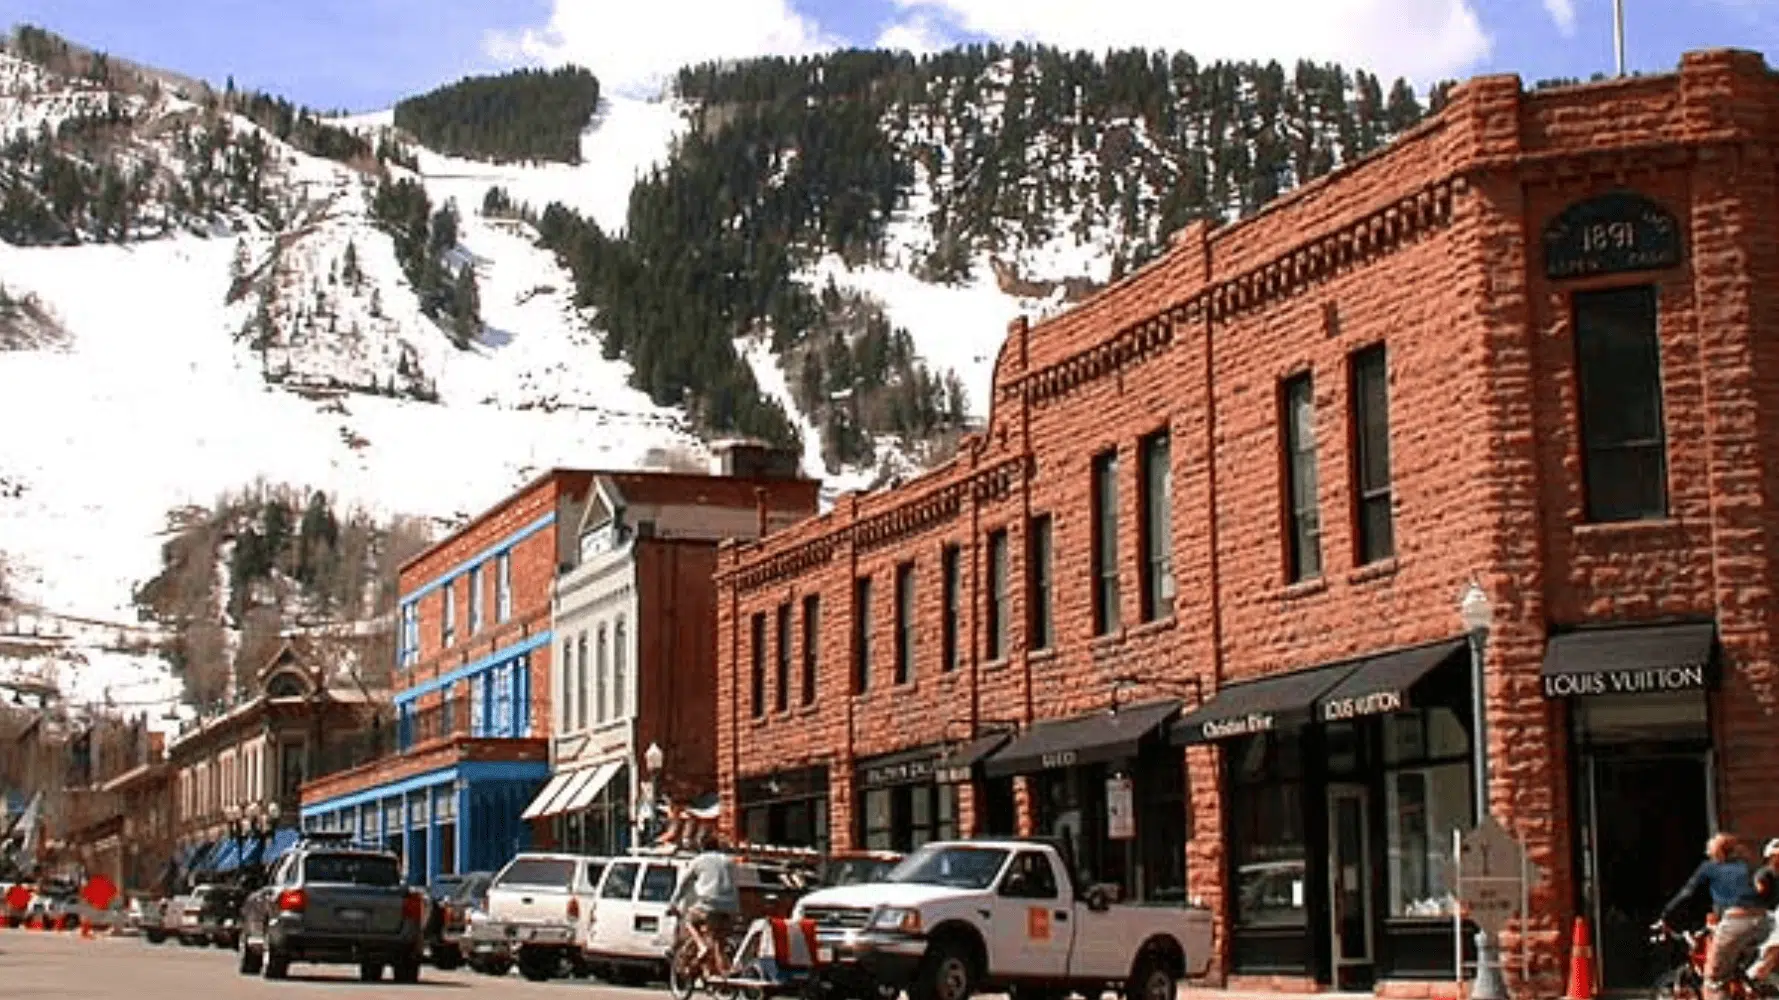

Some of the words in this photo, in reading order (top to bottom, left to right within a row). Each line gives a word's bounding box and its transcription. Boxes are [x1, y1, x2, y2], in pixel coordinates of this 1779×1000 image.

[1582, 221, 1634, 252] 1891
[1545, 672, 1605, 696] LOUIS
[1610, 665, 1703, 691] VUITTON
